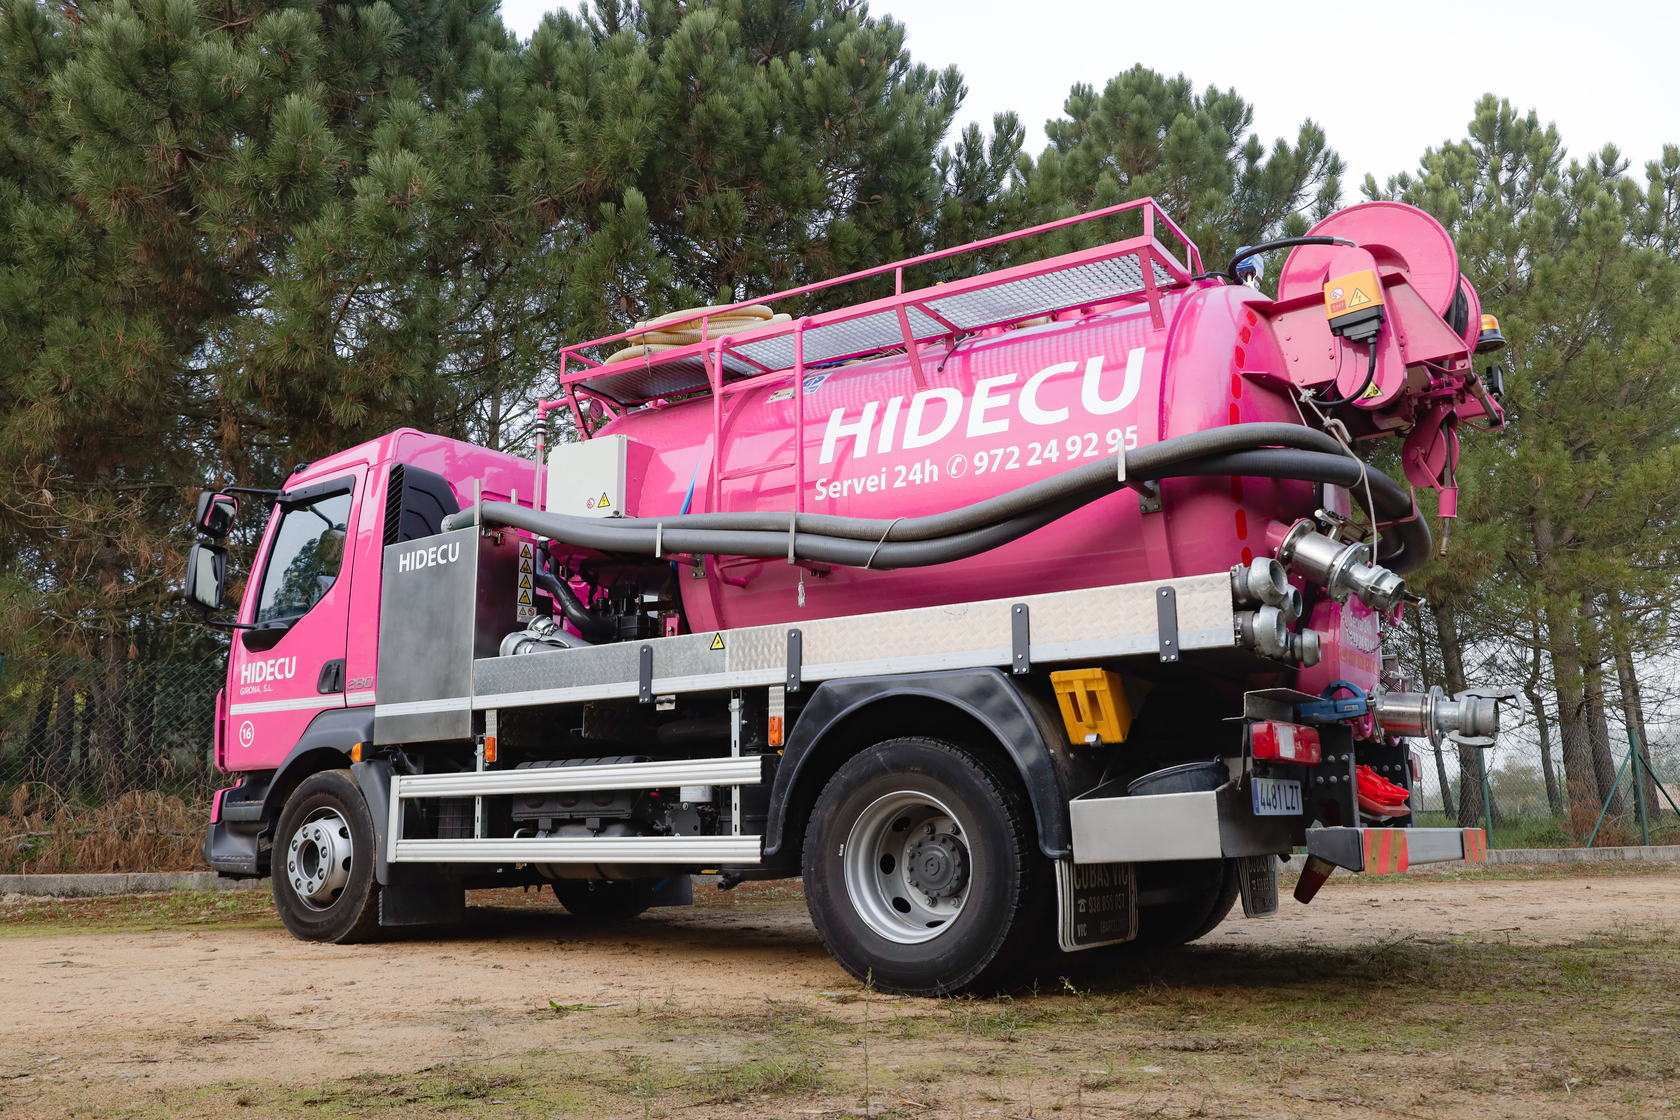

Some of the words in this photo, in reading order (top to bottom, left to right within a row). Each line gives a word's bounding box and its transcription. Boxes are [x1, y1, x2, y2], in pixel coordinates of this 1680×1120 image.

[818, 346, 1147, 465] HIDECU
[814, 467, 886, 501] Servei
[893, 458, 939, 489] 24h
[973, 448, 1020, 475] 972
[1027, 438, 1058, 466] 24
[1065, 432, 1099, 460] 92
[1105, 425, 1138, 455] 95
[399, 541, 460, 573] HIDECU
[240, 656, 297, 685] HIDECU
[346, 677, 374, 691] 280
[240, 684, 262, 696] GIRONA,
[263, 684, 274, 693] S.L.
[242, 727, 252, 740] 16
[1260, 782, 1282, 810] 4481
[1283, 784, 1300, 810] LZT
[1073, 864, 1110, 890] CUBAS
[1112, 862, 1128, 886] VIC
[1088, 896, 1101, 913] 938
[1102, 894, 1114, 912] 855
[1077, 923, 1088, 938] VIC
